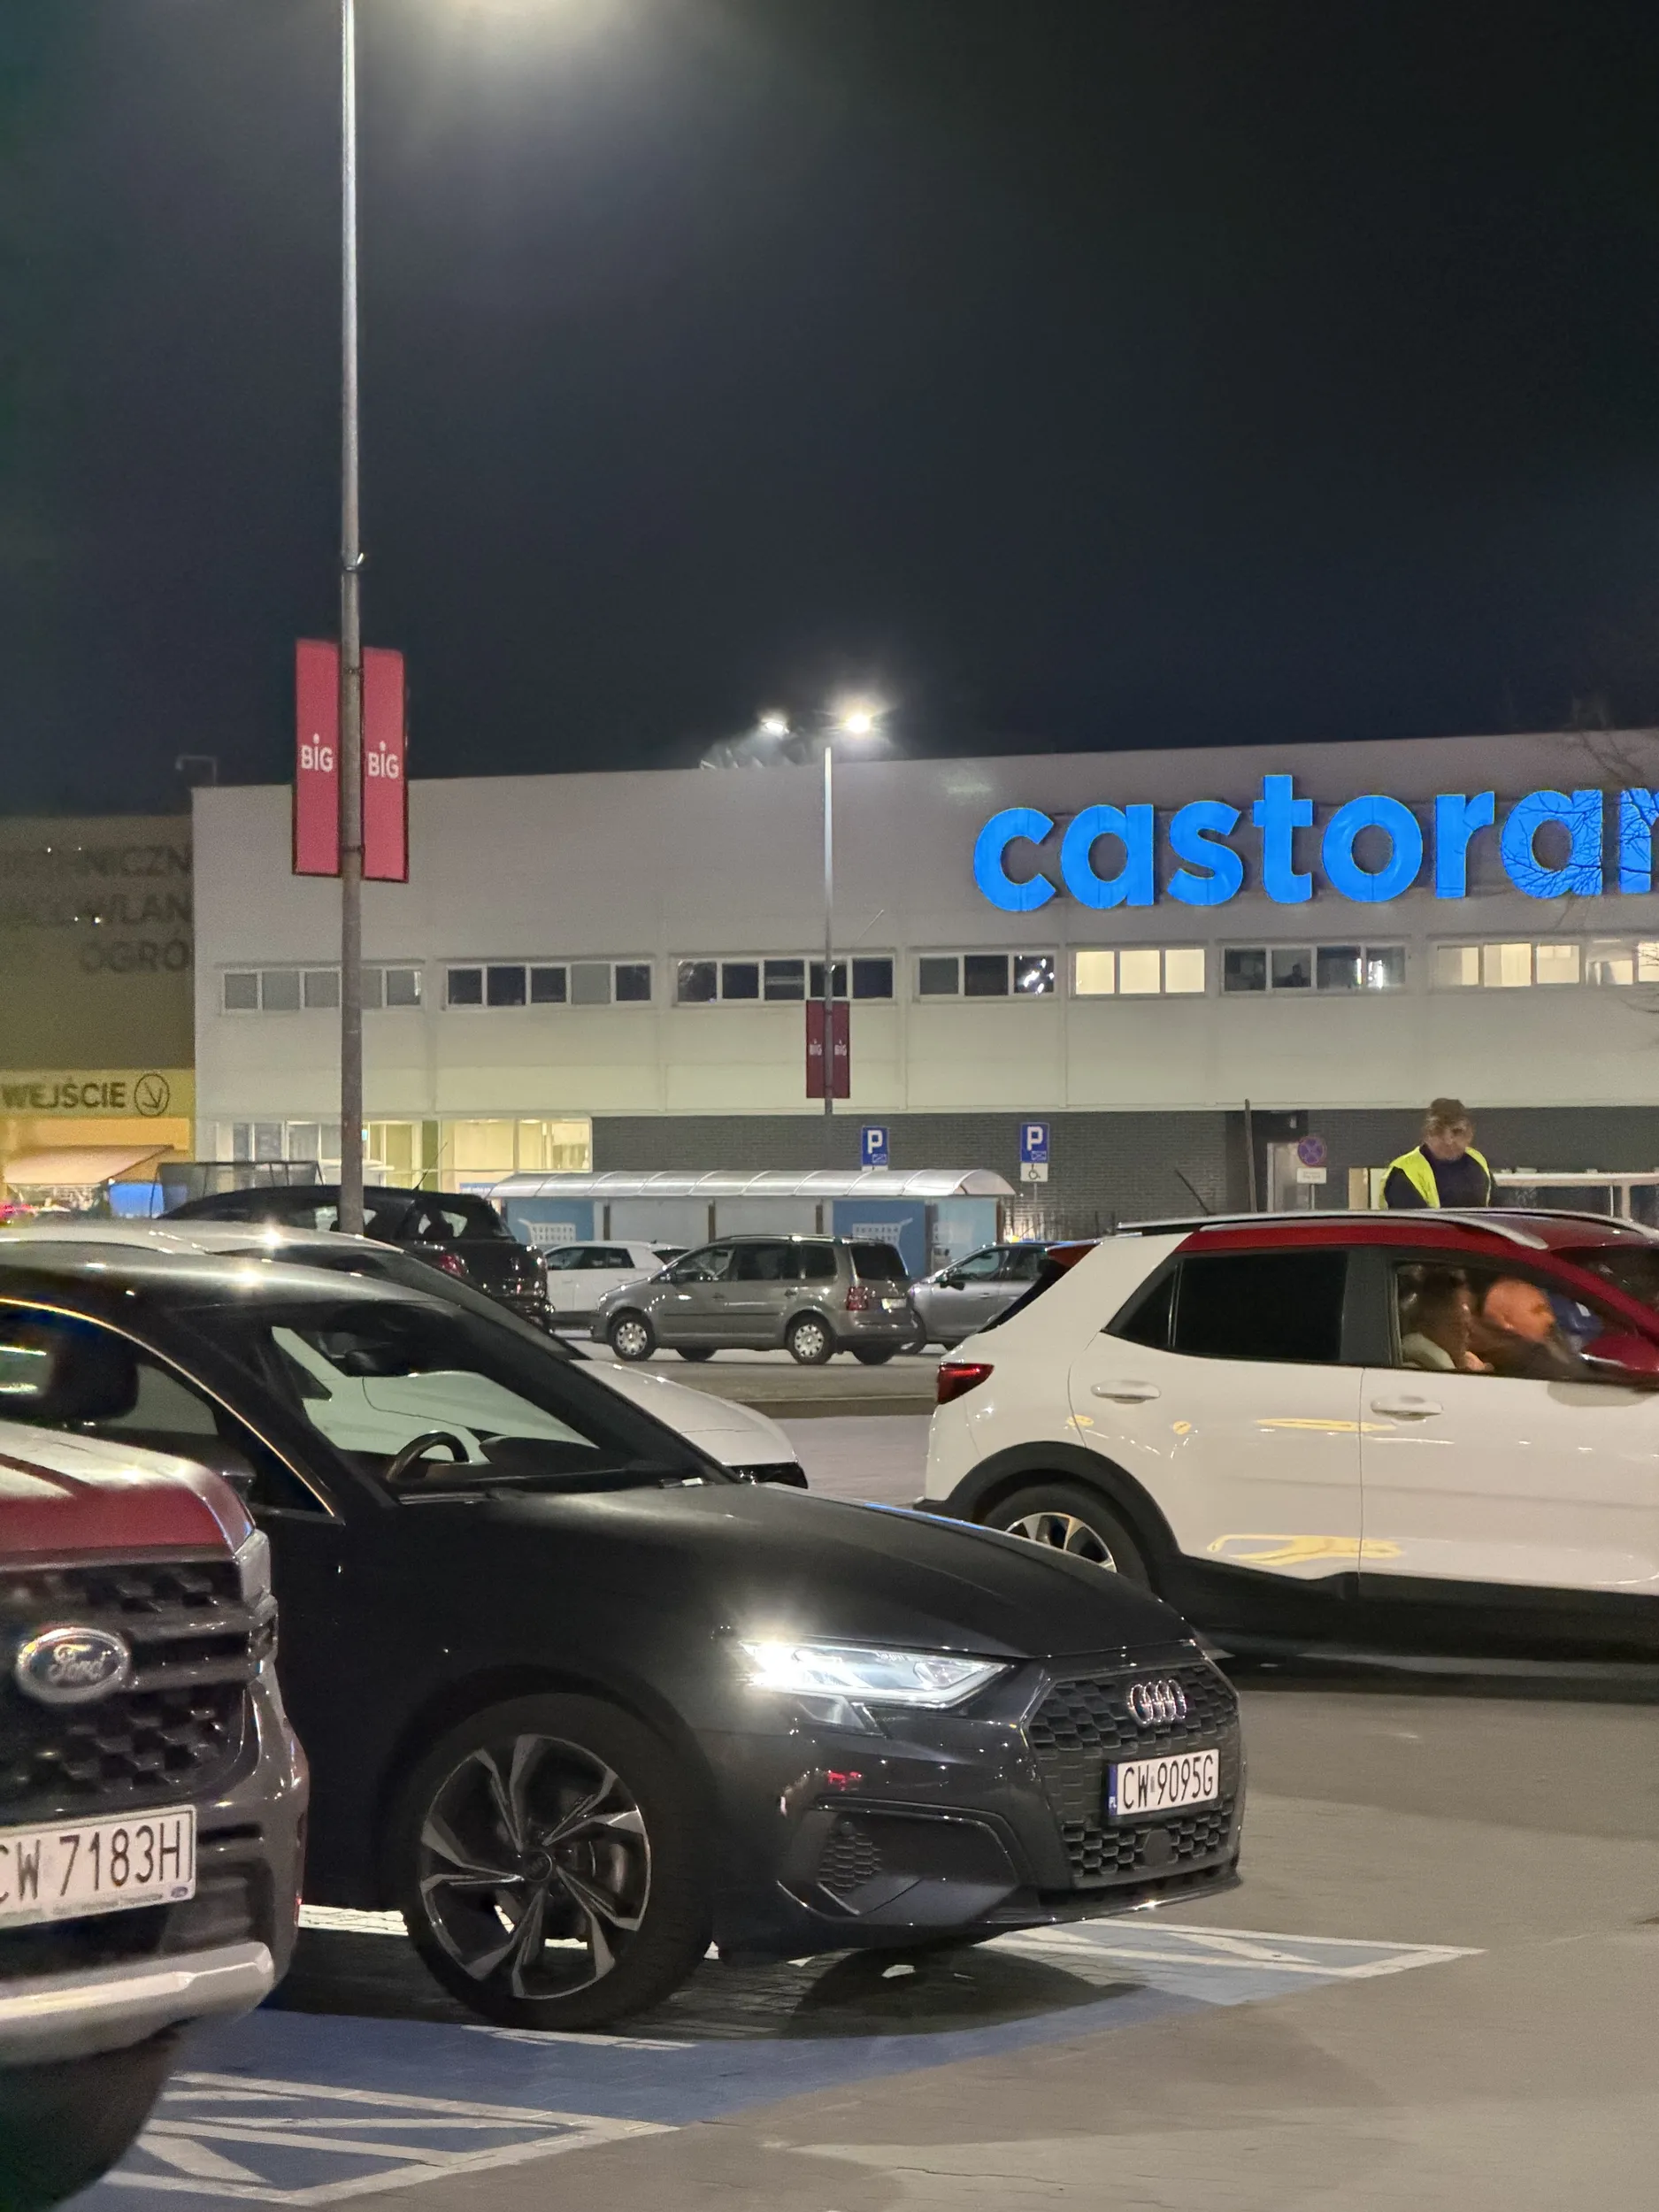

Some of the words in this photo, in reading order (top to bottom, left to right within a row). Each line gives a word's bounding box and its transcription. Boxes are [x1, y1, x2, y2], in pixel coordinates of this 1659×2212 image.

[2, 1076, 126, 1108] WEJŚCIE
[867, 1130, 883, 1154] P
[1027, 1126, 1043, 1150] P
[47, 1644, 111, 1682] Ford
[1123, 1764, 1149, 1809] CW
[1157, 1755, 1213, 1805] 9095G
[59, 1820, 180, 1897] 7183H
